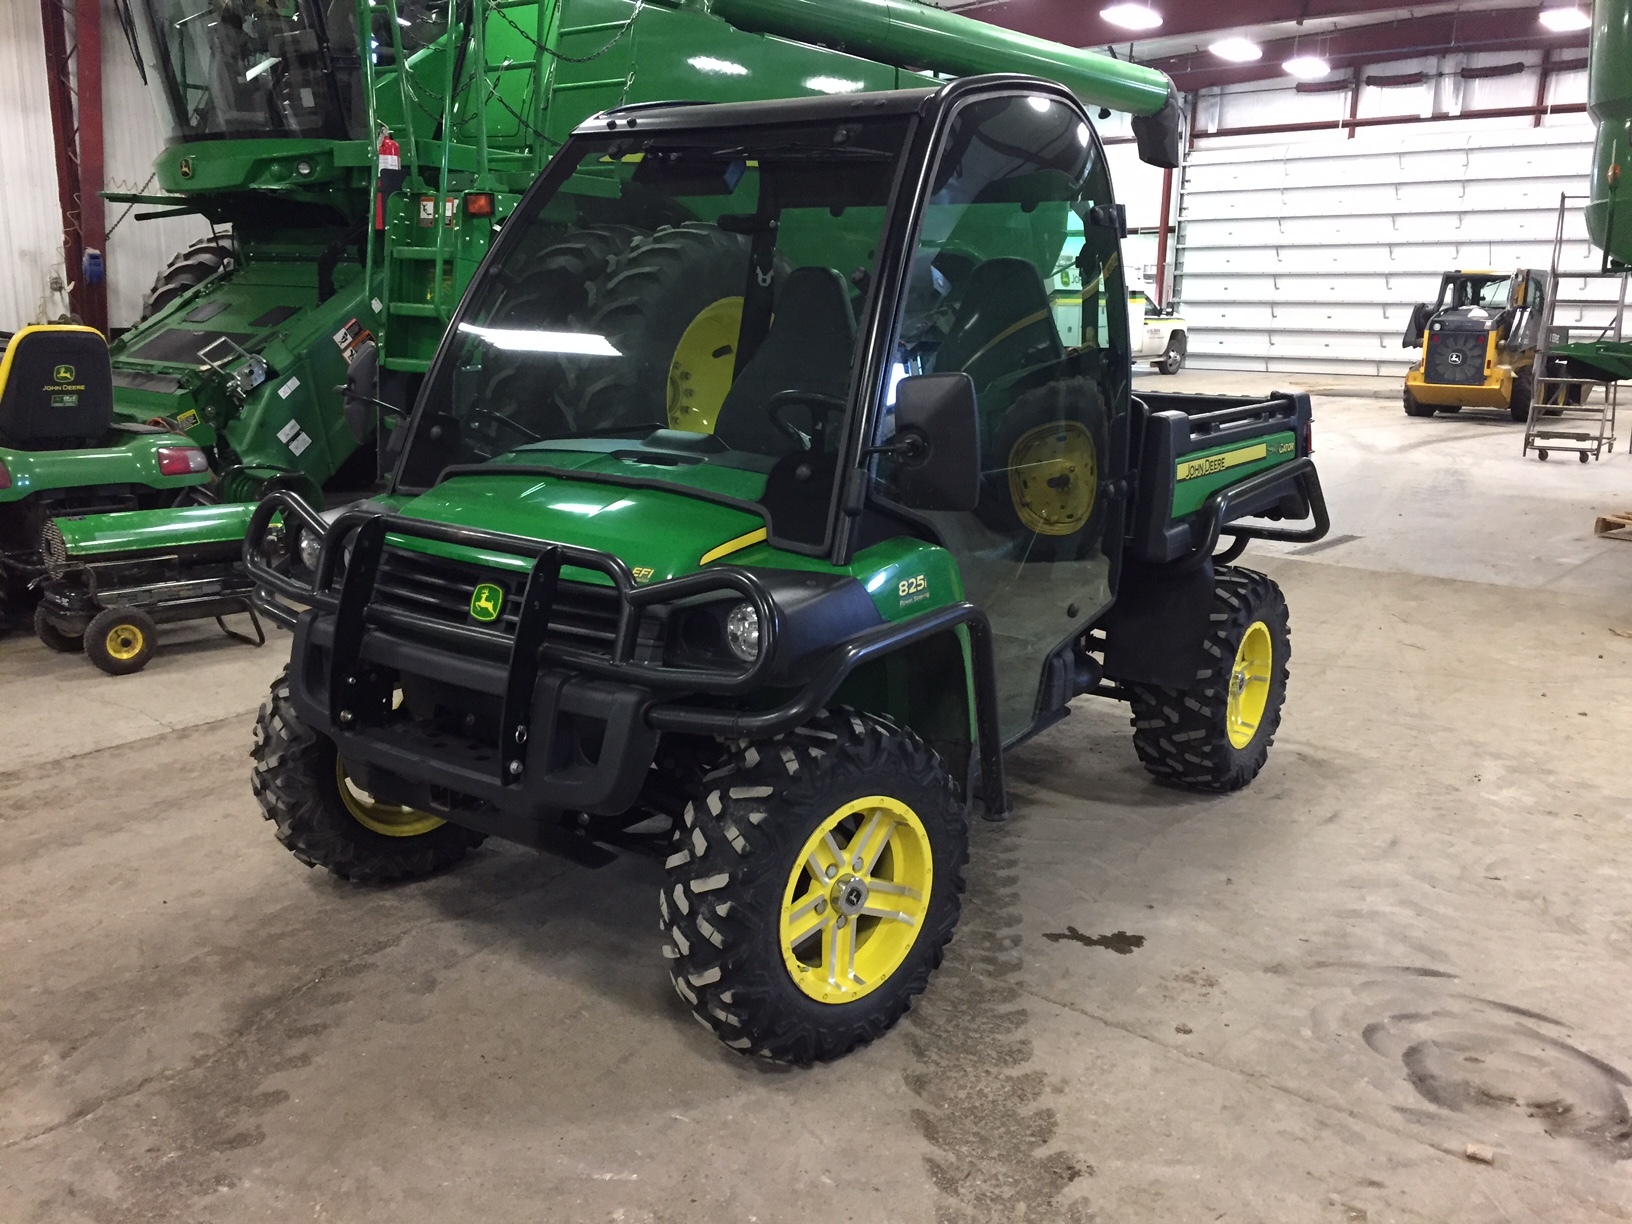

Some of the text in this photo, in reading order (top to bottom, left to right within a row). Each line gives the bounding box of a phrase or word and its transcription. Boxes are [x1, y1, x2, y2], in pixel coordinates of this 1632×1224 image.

[1279, 442, 1295, 454] GATOR
[1185, 457, 1226, 480] JOHN DEERE
[632, 566, 655, 579] EFI
[898, 574, 928, 597] 825i
